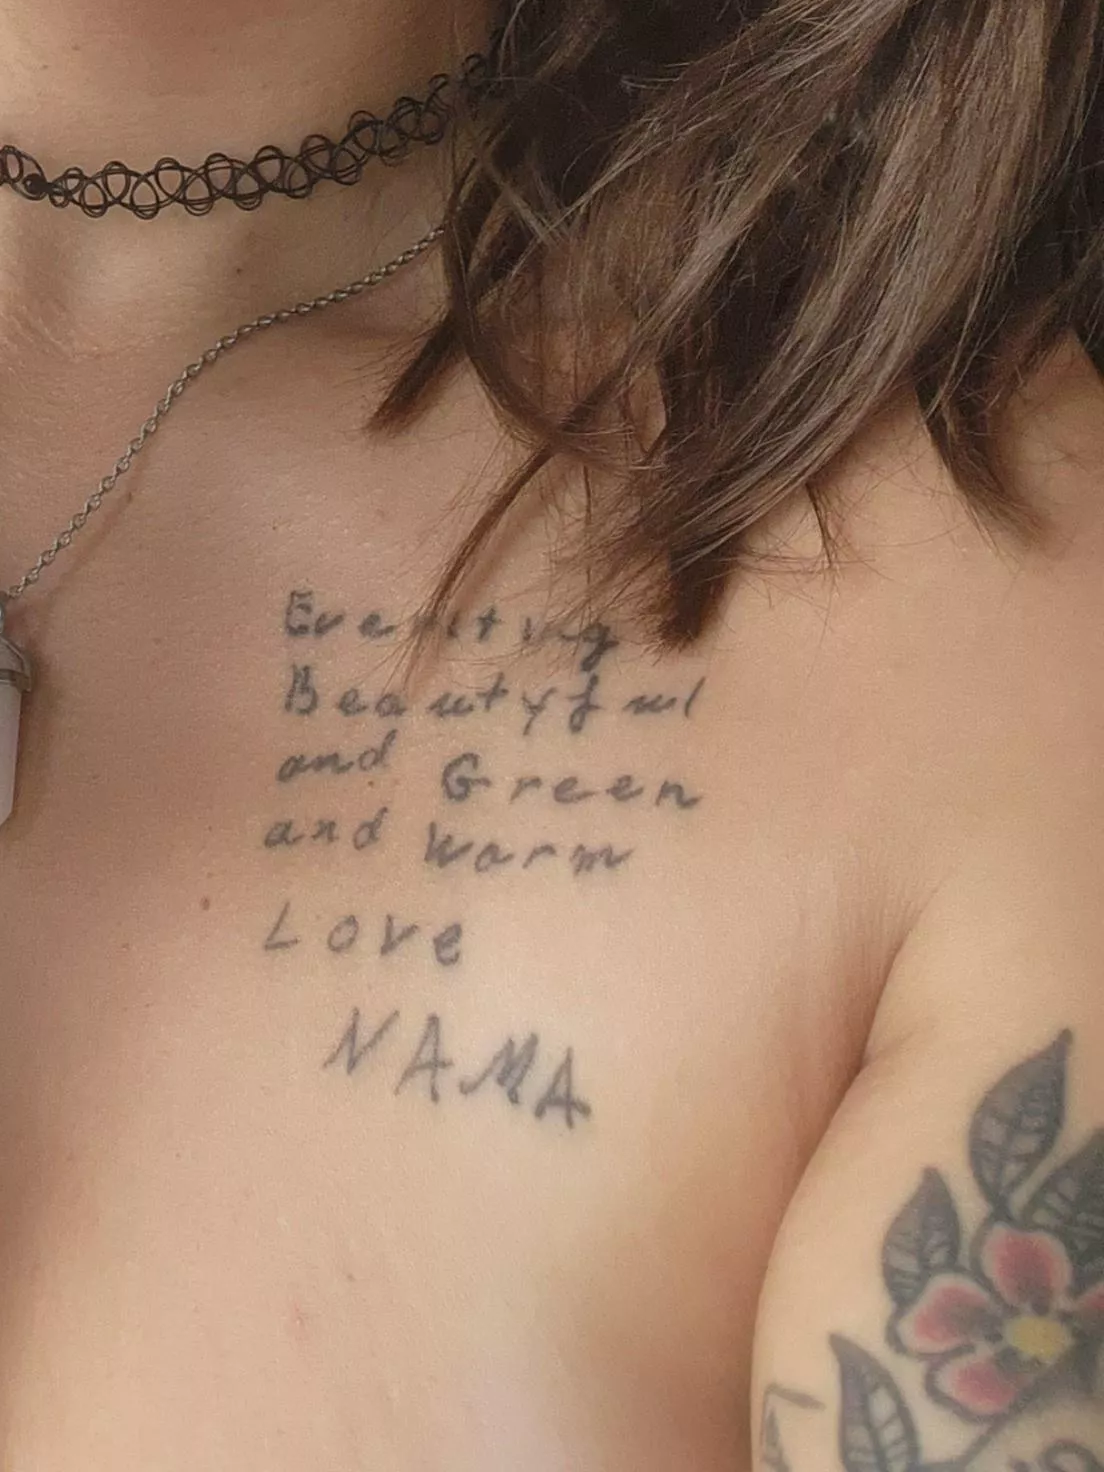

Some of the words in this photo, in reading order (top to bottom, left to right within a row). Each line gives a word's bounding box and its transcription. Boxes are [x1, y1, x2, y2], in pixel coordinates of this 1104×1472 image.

[277, 728, 397, 783] and
[441, 751, 703, 804] Green
[265, 807, 388, 850] and
[322, 1006, 592, 1129] NAMA
